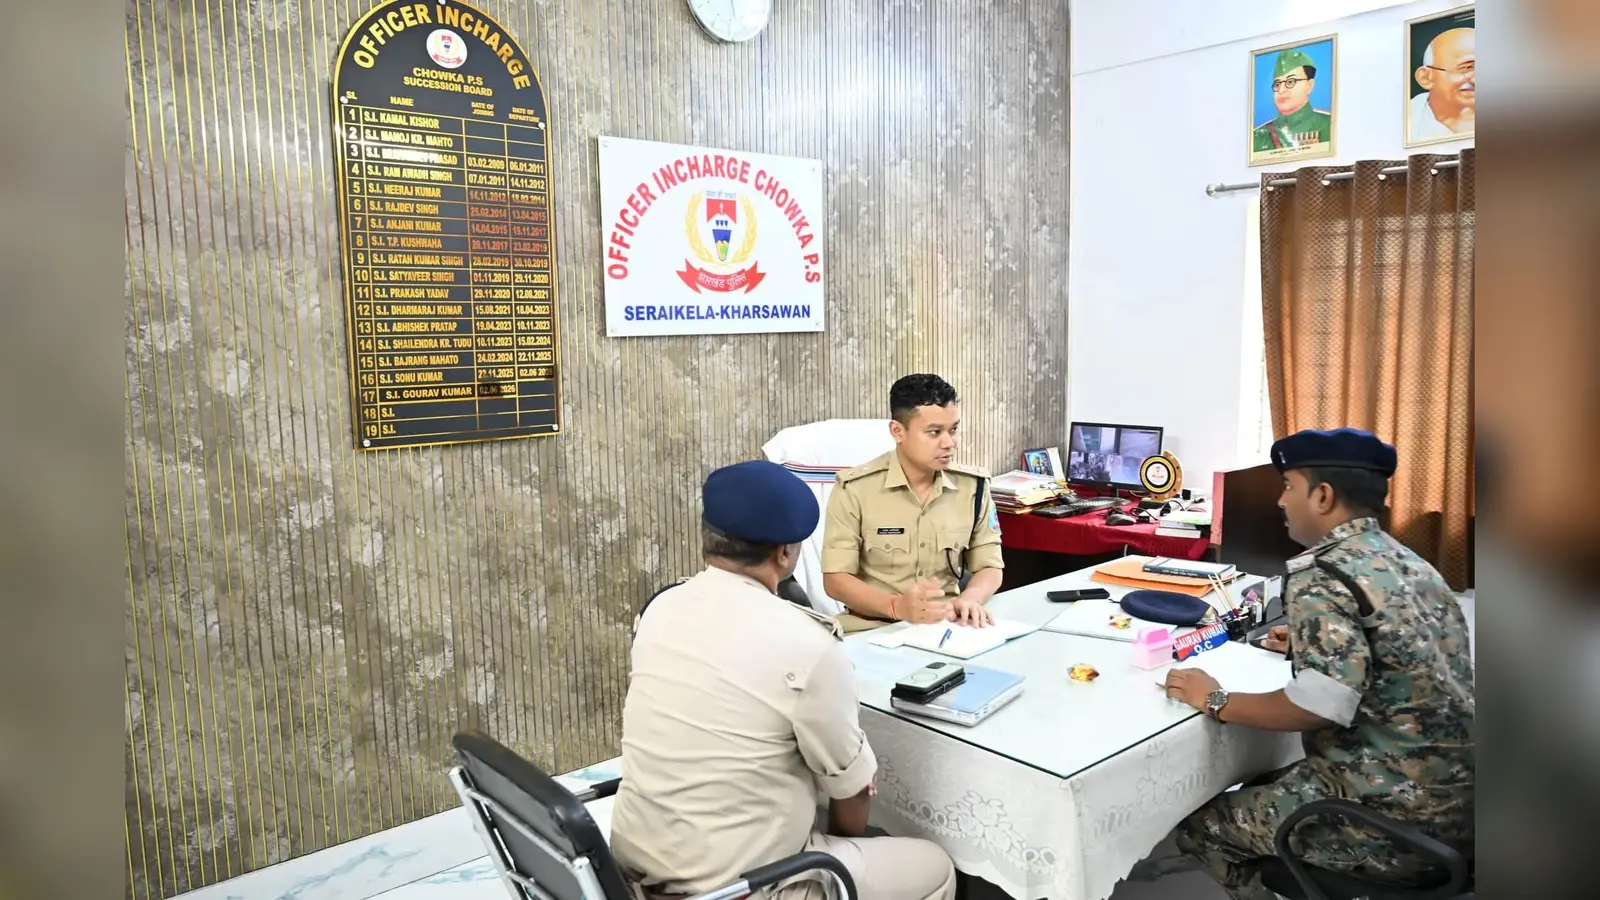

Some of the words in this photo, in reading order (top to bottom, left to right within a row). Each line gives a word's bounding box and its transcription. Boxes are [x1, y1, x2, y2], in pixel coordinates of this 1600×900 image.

[354, 4, 432, 68] OFFICER
[437, 5, 531, 90] INCHARGE
[413, 67, 464, 83] CHOWKA
[467, 75, 483, 85] P.S
[404, 76, 461, 93] SUCCESSION
[464, 85, 492, 96] BOARD
[390, 96, 414, 106] NAME
[349, 109, 355, 120] 1
[364, 111, 378, 122] S.I.
[380, 113, 408, 125] KAMAL
[410, 116, 439, 128] KISHOR
[509, 113, 540, 122] DEPARTURE
[349, 127, 357, 139] 2
[365, 129, 379, 140] S.I.
[381, 131, 410, 142] MANOJ
[411, 134, 424, 145] KR.
[426, 136, 453, 147] MAHTO
[350, 145, 358, 156] 3
[366, 147, 380, 158] S.I.
[468, 157, 505, 169] 03.02.2009
[510, 161, 544, 174] 06.01.2011
[352, 163, 359, 175] 4
[367, 165, 381, 176] S.I.
[384, 167, 400, 177] RAM
[402, 168, 429, 179] AWADH
[430, 170, 452, 181] SINGH
[469, 174, 505, 185] 07.01.2011
[511, 178, 545, 189] 14.11.2012
[353, 182, 360, 193] 5
[368, 183, 382, 193] S.I.
[384, 184, 413, 195] NEERAJ
[415, 187, 441, 197] KUMAR
[470, 191, 506, 202] 14.11.2012
[354, 199, 360, 210] 6
[370, 201, 383, 211] S.I.
[385, 202, 414, 212] RAJDEV
[416, 204, 438, 214] SINGH
[355, 217, 362, 228] 7
[370, 218, 384, 228] S.I.
[386, 220, 414, 230] ANJANI
[415, 221, 441, 231] KUMAR
[608, 182, 657, 279] OFFICER
[652, 155, 751, 193] INCHARGE
[754, 169, 814, 249] CHOWKA
[803, 253, 820, 283] P.S
[356, 235, 362, 246] 8
[371, 236, 385, 246] S.I.
[387, 237, 399, 246] T.P.
[401, 237, 442, 248] KUSHWAHA
[357, 253, 364, 264] 9
[372, 253, 386, 263] S.I.
[388, 254, 412, 264] RATAN
[414, 255, 440, 265] KUMAR
[441, 256, 463, 266] SINGH
[355, 270, 368, 281] 10
[374, 271, 387, 280] S.I.
[389, 271, 430, 281] SATYAVEER
[432, 273, 454, 282] SINGH
[474, 272, 510, 282] 01.11.2019
[515, 274, 548, 283] 29.11.2020
[358, 287, 369, 298] 11
[375, 288, 388, 298] S.I.
[390, 288, 425, 298] PRAKASH
[426, 289, 449, 298] YADAV
[474, 289, 510, 298] 29.11.2020
[358, 305, 370, 316] 12
[376, 305, 389, 315] S.I.
[391, 305, 436, 315] DHARMARAJ
[437, 306, 462, 314] KUMAR
[625, 305, 810, 321] SERAIKELA-KHARSAWAN
[359, 322, 371, 333] 13
[377, 322, 390, 332] S.I.
[392, 322, 429, 332] ABHISHEK
[431, 322, 457, 331] PRATAP
[476, 321, 512, 330] 19.04.2023
[517, 321, 550, 330] 10.11.2023
[360, 340, 372, 350] 14
[378, 340, 391, 349] S.I.
[393, 339, 438, 349] SHAILENDRA
[440, 339, 451, 348] KR.
[453, 339, 472, 347] TUDU
[477, 337, 512, 346] 10.11.2023
[518, 336, 550, 345] 15.02.2024
[361, 357, 373, 367] 15
[379, 357, 392, 366] S.I.
[394, 356, 428, 366] BAJRANG
[430, 355, 458, 364] MAHATO
[478, 353, 513, 362] 24.02.2024
[518, 352, 551, 361] 22.11.2025
[362, 374, 374, 385] 16
[380, 374, 393, 383] S.I.
[395, 373, 415, 382] SONU
[417, 372, 443, 381] KUMAR
[363, 391, 375, 402] 17
[386, 391, 400, 399] S.I.
[403, 389, 439, 398] GOURAV
[442, 387, 472, 396] KUMAR
[364, 408, 376, 419] 18
[382, 408, 395, 417] S.I.
[366, 425, 377, 436] 19
[383, 424, 396, 434] S.I.
[1173, 631, 1202, 650] GAURAV
[1200, 624, 1226, 640] KUMAR
[1194, 641, 1213, 653] O.C
